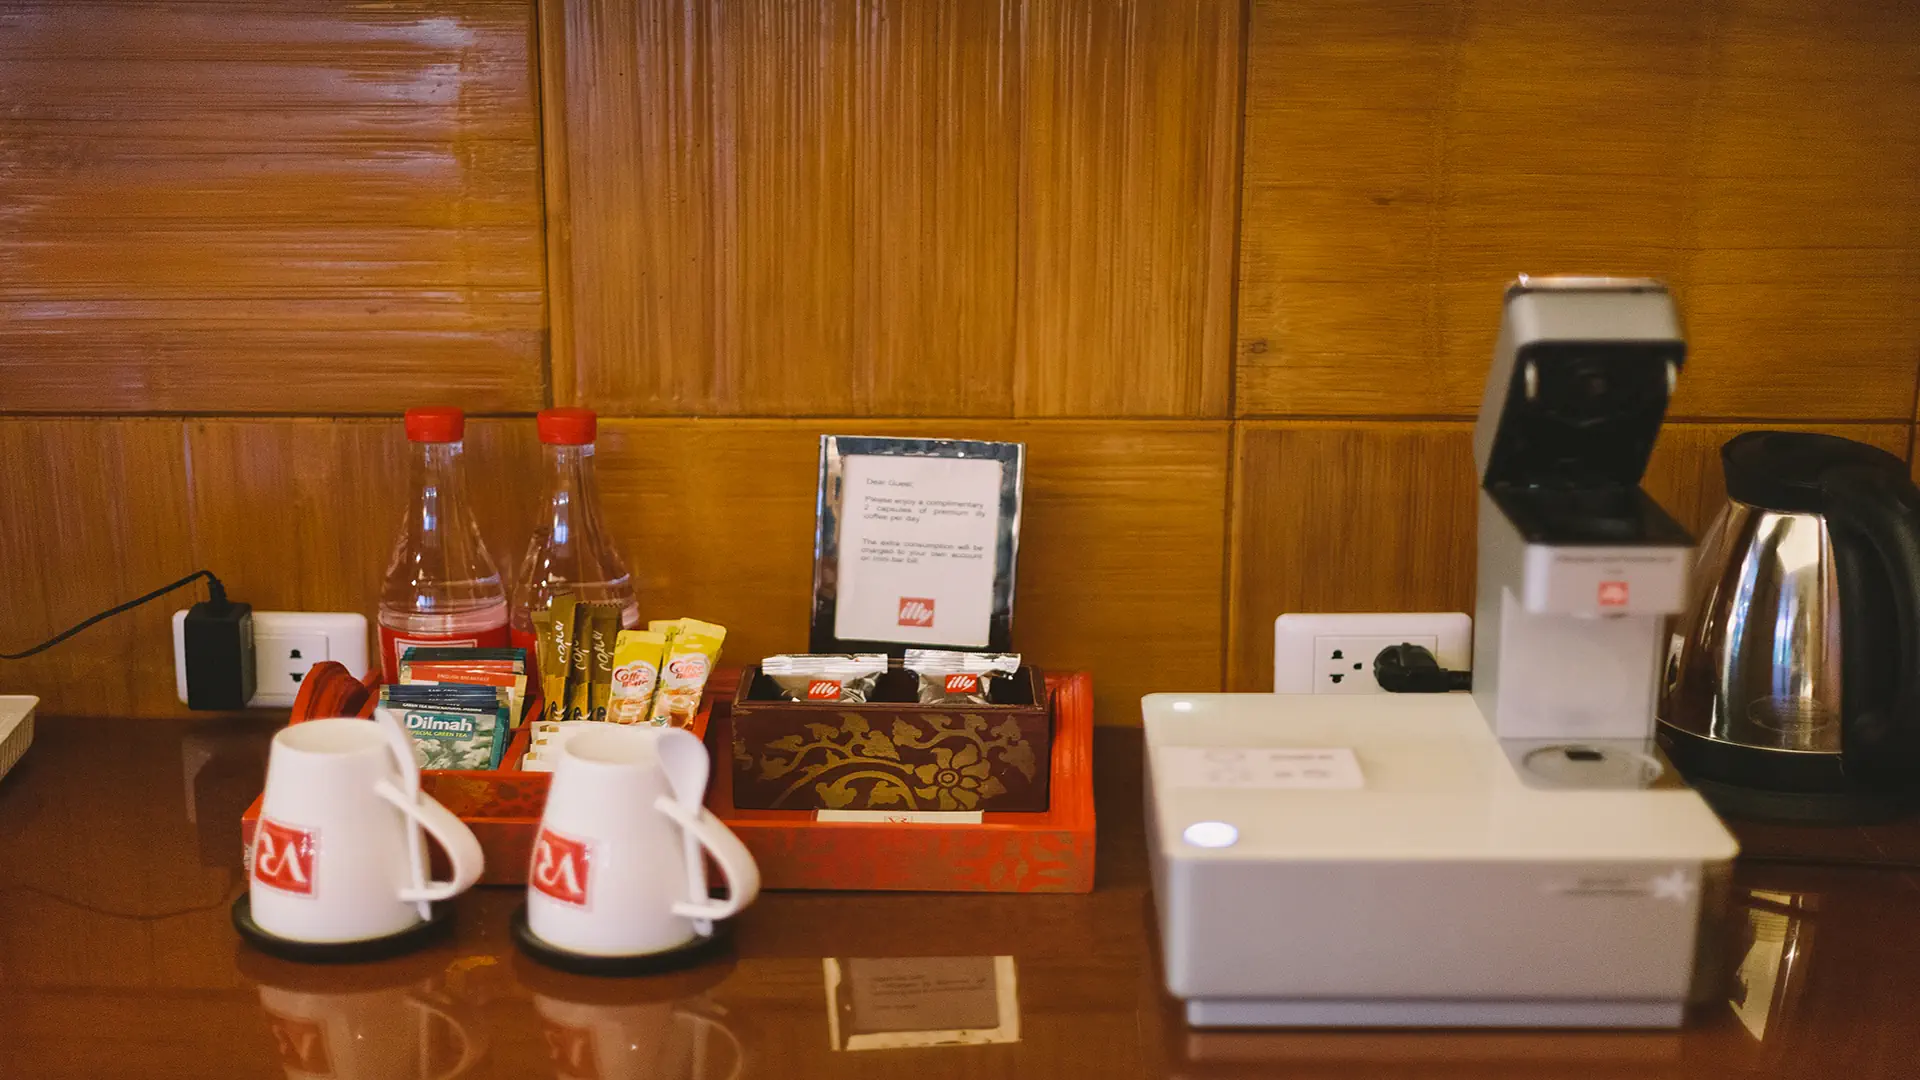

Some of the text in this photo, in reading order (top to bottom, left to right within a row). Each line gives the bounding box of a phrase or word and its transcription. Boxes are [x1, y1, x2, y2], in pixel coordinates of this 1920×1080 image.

[926, 500, 984, 509] complimentary
[933, 509, 969, 517] premium
[860, 547, 894, 556] charged
[904, 541, 954, 550] consumption
[899, 601, 934, 625] illy
[614, 668, 649, 682] Coffee
[809, 681, 839, 699] illy
[947, 674, 976, 692] illy
[406, 714, 473, 732] Dilmah
